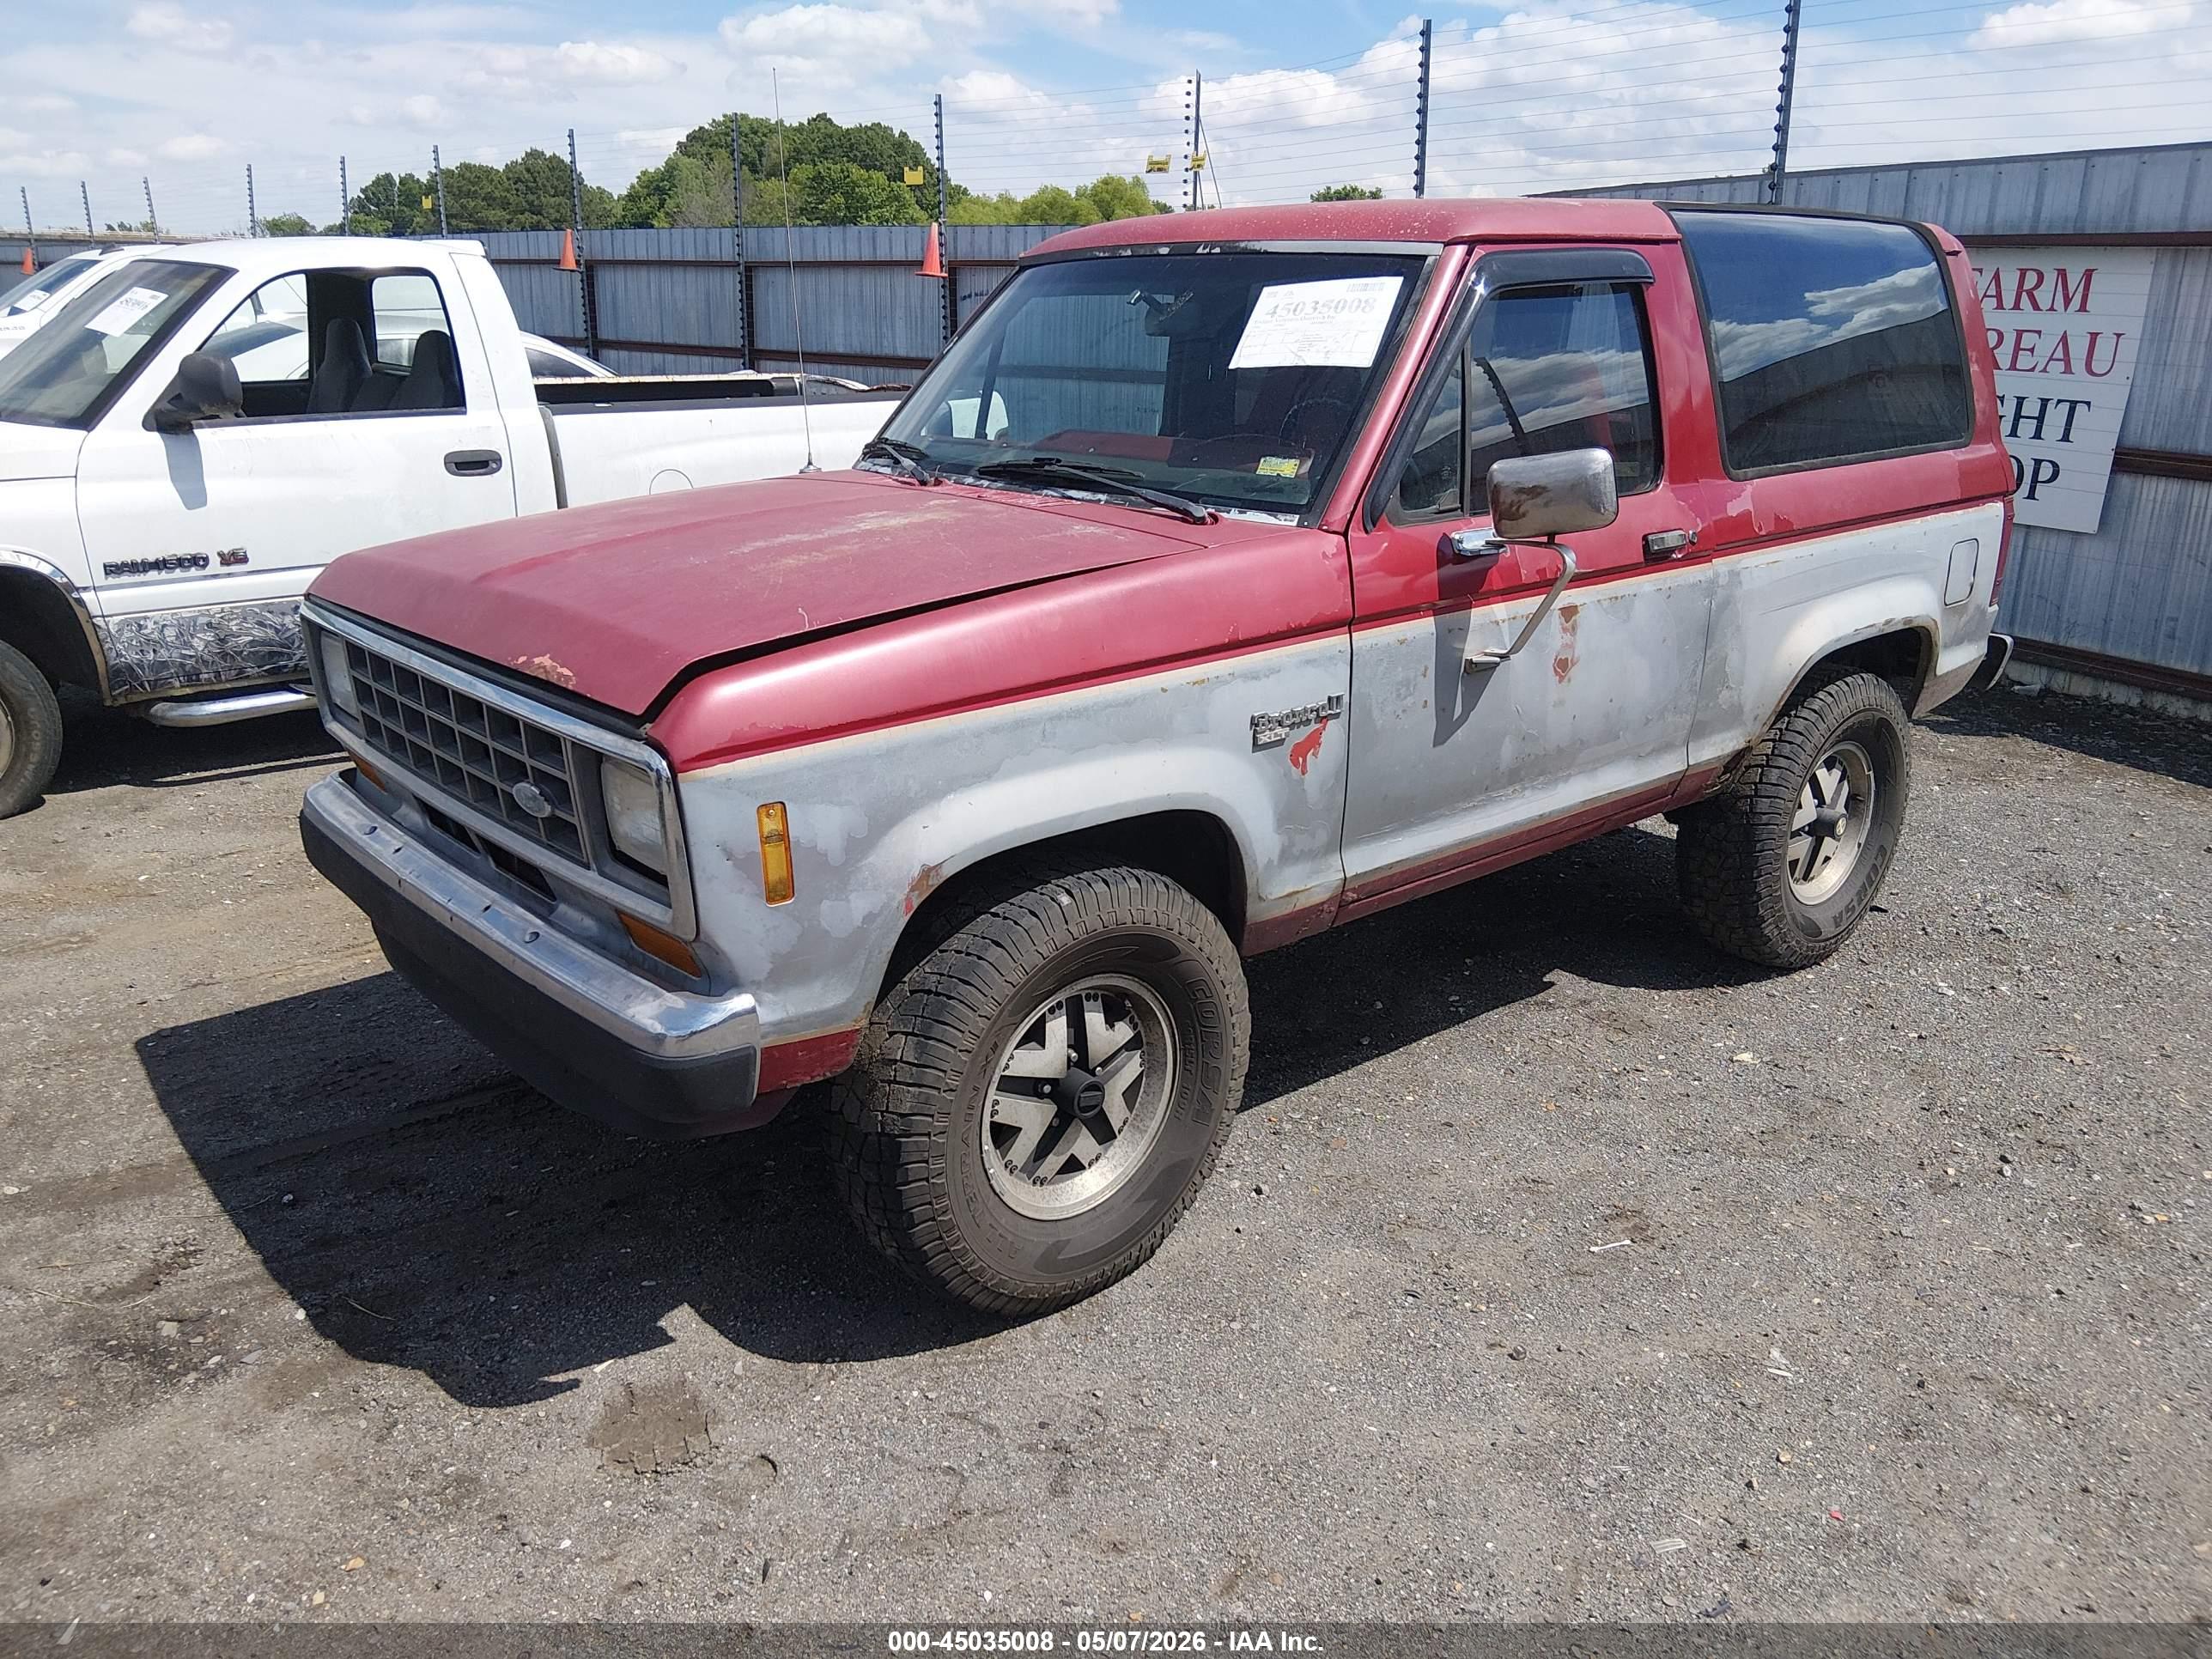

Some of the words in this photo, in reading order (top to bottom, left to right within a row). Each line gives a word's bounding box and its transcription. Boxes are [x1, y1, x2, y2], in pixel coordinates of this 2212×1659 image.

[1265, 296, 1378, 318] 45035008
[1249, 701, 1328, 732] Bronco
[1328, 692, 1345, 714] II
[1255, 726, 1291, 745] XLT
[1184, 975, 1224, 1127] CORSA
[959, 1084, 985, 1229] TERRAIN
